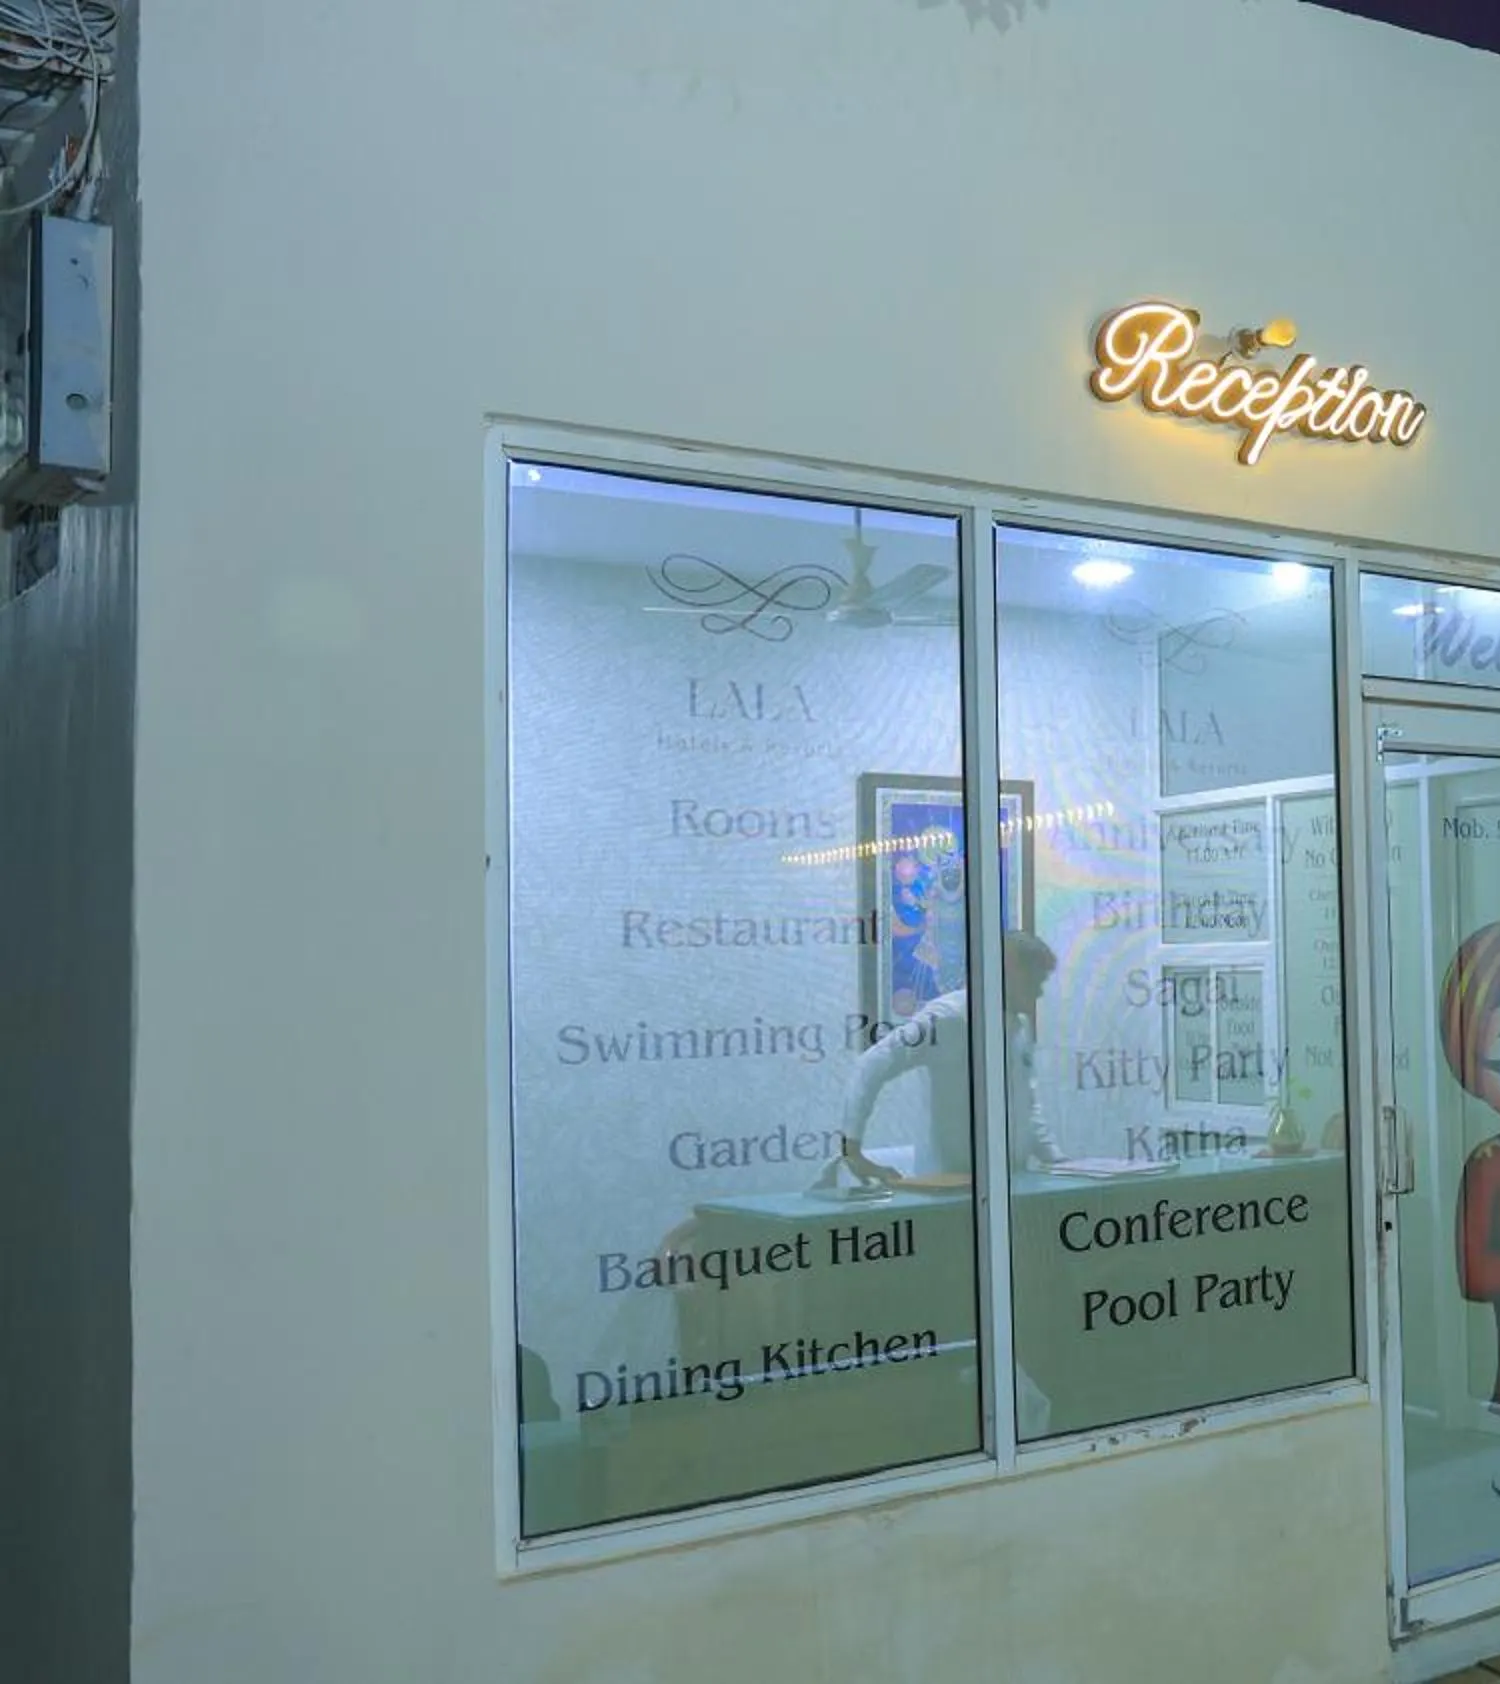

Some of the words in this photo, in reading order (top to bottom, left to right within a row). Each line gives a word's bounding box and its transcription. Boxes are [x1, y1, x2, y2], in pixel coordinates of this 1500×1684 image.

[1092, 301, 1426, 465] Reception
[687, 677, 819, 723] LALA
[669, 797, 838, 841] Rooms
[1442, 816, 1489, 840] Mob.
[620, 908, 881, 950] Restaurant
[556, 1016, 827, 1066] Swimming
[843, 1012, 938, 1051] Pool
[1075, 1044, 1171, 1095] Kitty
[1190, 1039, 1288, 1088] Party
[668, 1124, 848, 1172] Garden
[1126, 1119, 1248, 1164] Katha
[1058, 1193, 1310, 1254] Conference
[597, 1231, 812, 1293] Banquet
[828, 1219, 915, 1265] Hall
[1083, 1278, 1178, 1332] Pool
[1195, 1264, 1295, 1311] Party
[576, 1356, 746, 1414] Dining
[760, 1328, 938, 1383] Kitchen
